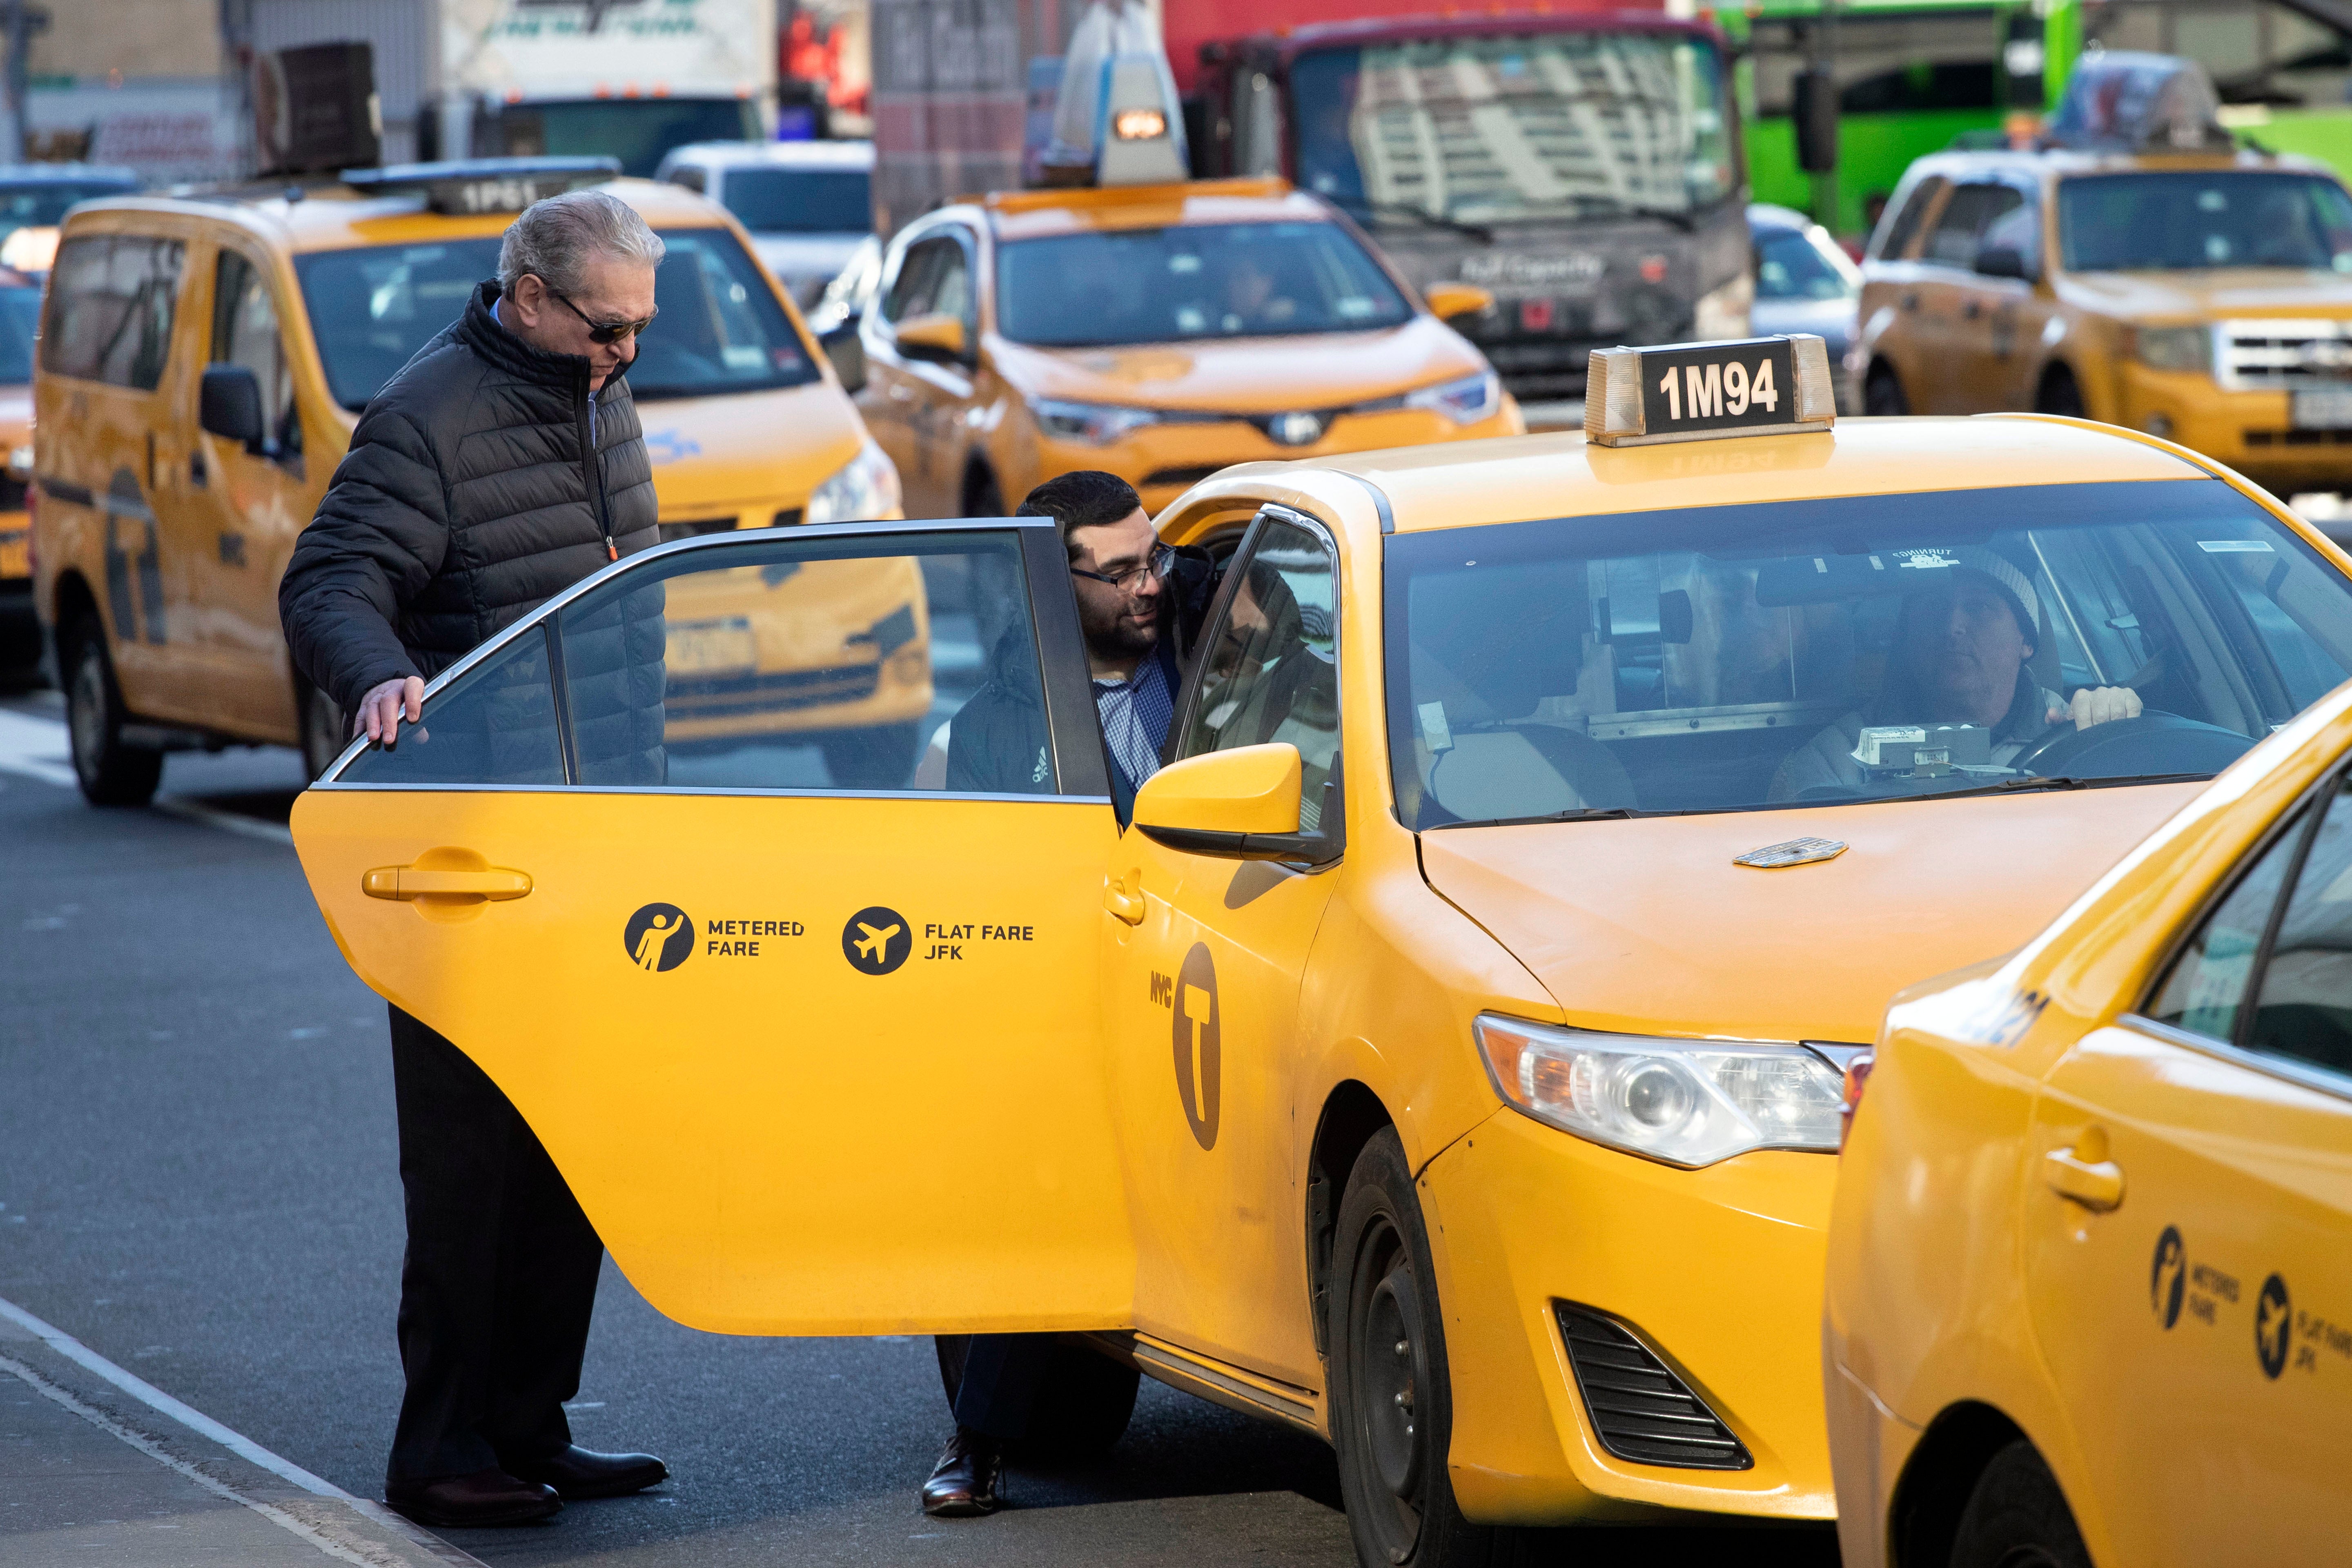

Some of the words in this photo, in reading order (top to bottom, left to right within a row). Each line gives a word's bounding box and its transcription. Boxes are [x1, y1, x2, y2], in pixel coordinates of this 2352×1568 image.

[1660, 359, 1778, 420] 1M94
[708, 920, 804, 936] METERED
[925, 924, 975, 939] FLAT
[982, 925, 1033, 941] FARE
[708, 941, 760, 956] FARE
[924, 945, 963, 960] JFK
[1150, 970, 1172, 1009] NYC
[1184, 983, 1210, 1122] T
